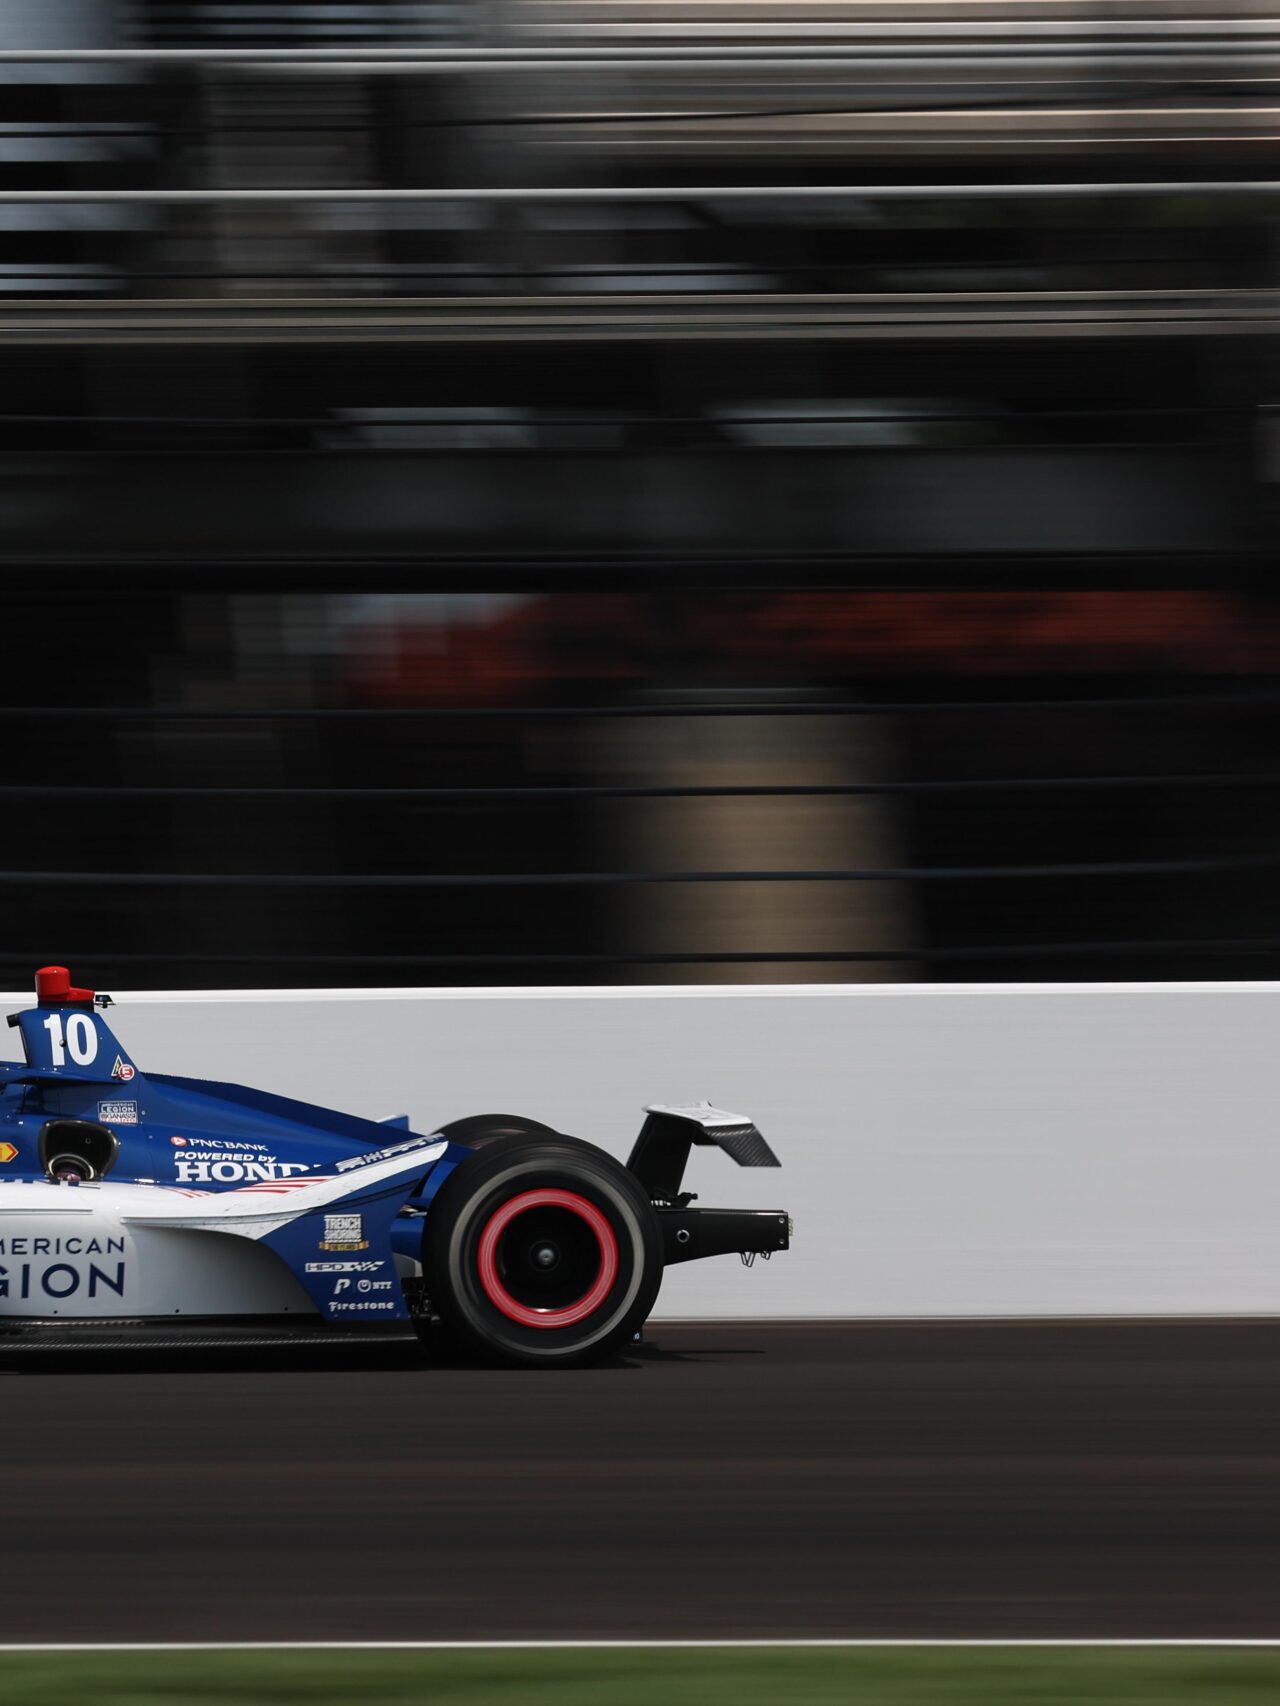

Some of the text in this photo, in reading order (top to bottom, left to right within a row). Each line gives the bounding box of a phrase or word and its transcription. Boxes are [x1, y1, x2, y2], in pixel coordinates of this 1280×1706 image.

[44, 1013, 98, 1066] 10
[100, 1105, 135, 1113] LEGION
[174, 1151, 277, 1163] POWERED by
[175, 1161, 322, 1182] HOND
[324, 1218, 361, 1229] TRENCH
[307, 1263, 345, 1271] HPD
[372, 1281, 392, 1289] NTT
[328, 1301, 395, 1312] Firestone
